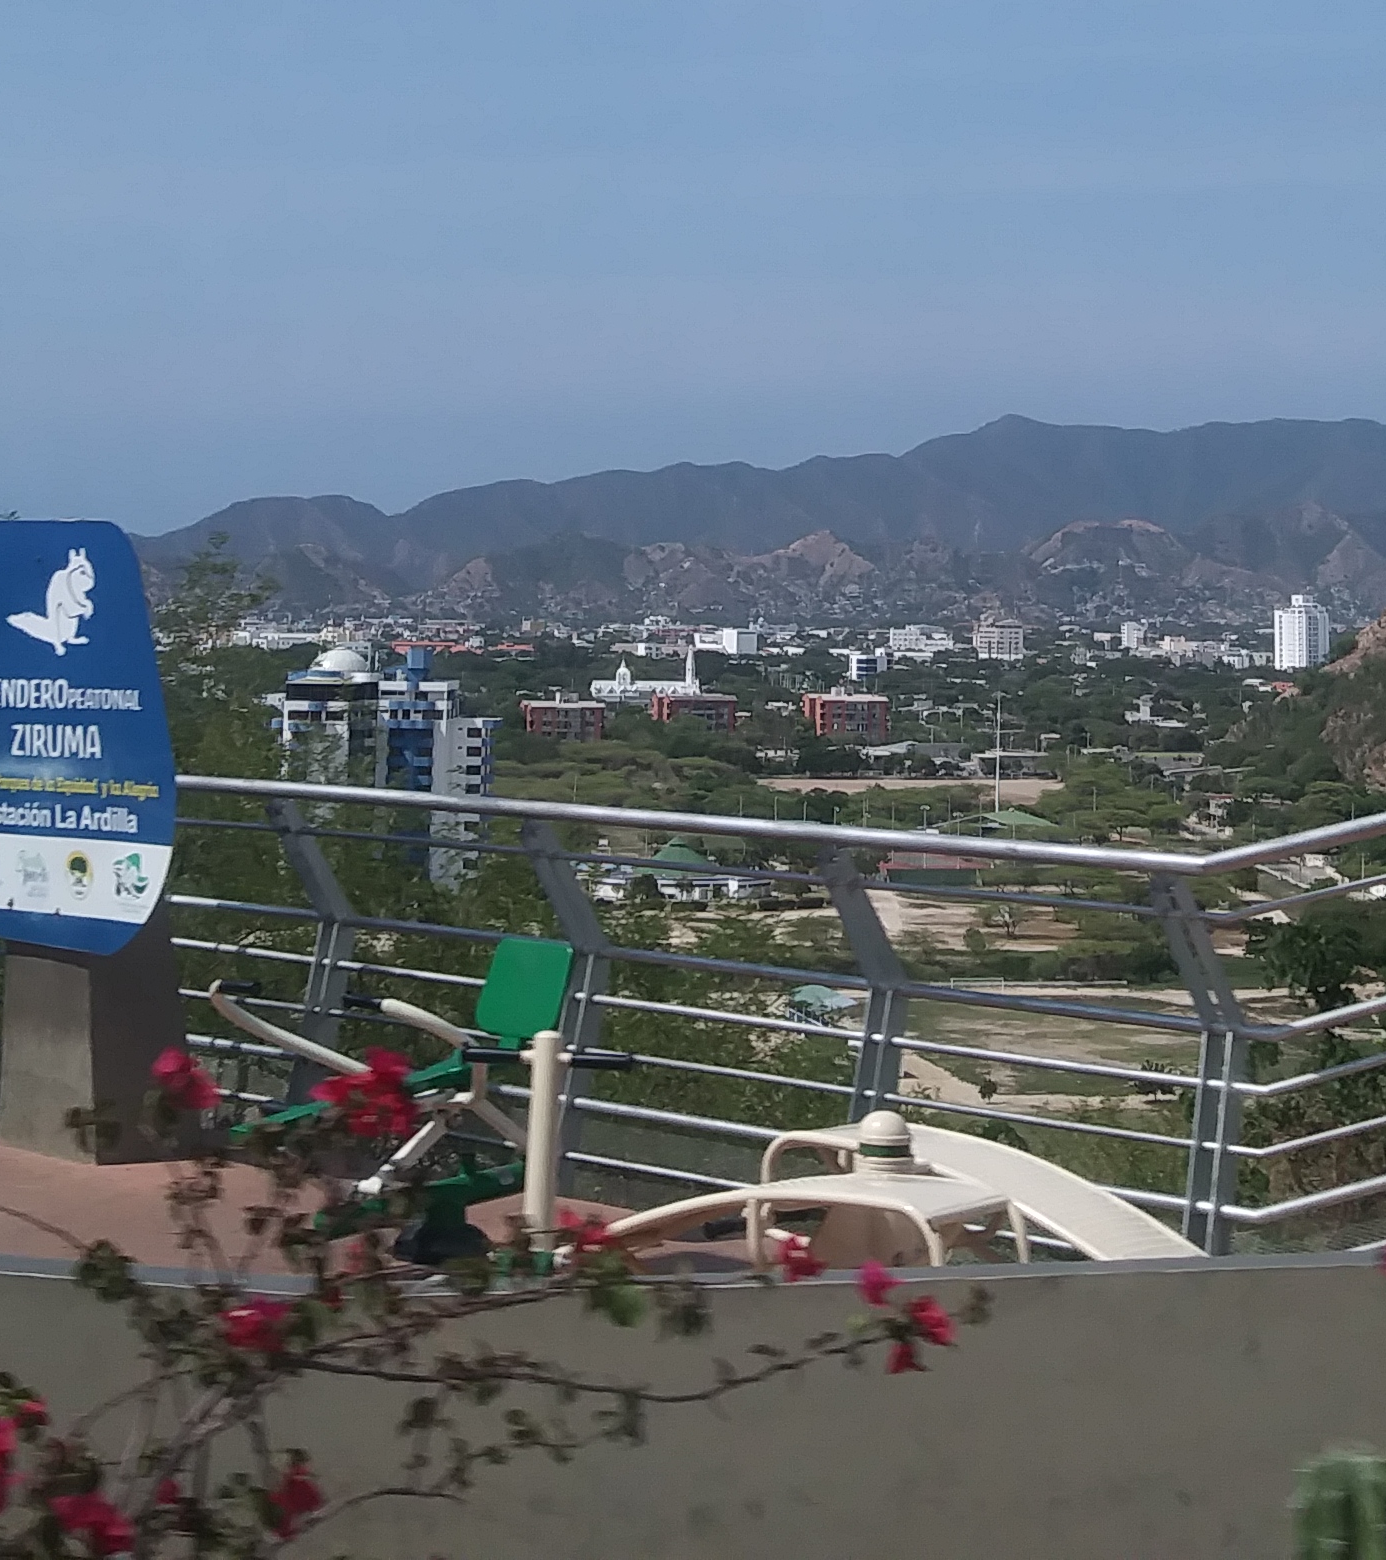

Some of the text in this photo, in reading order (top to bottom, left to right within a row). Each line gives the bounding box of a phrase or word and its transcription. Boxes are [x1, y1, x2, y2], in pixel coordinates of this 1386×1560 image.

[67, 688, 143, 711] PEATONAL
[10, 724, 102, 759] ZIRUMA
[54, 804, 78, 830] La
[79, 805, 139, 834] Ardilla
